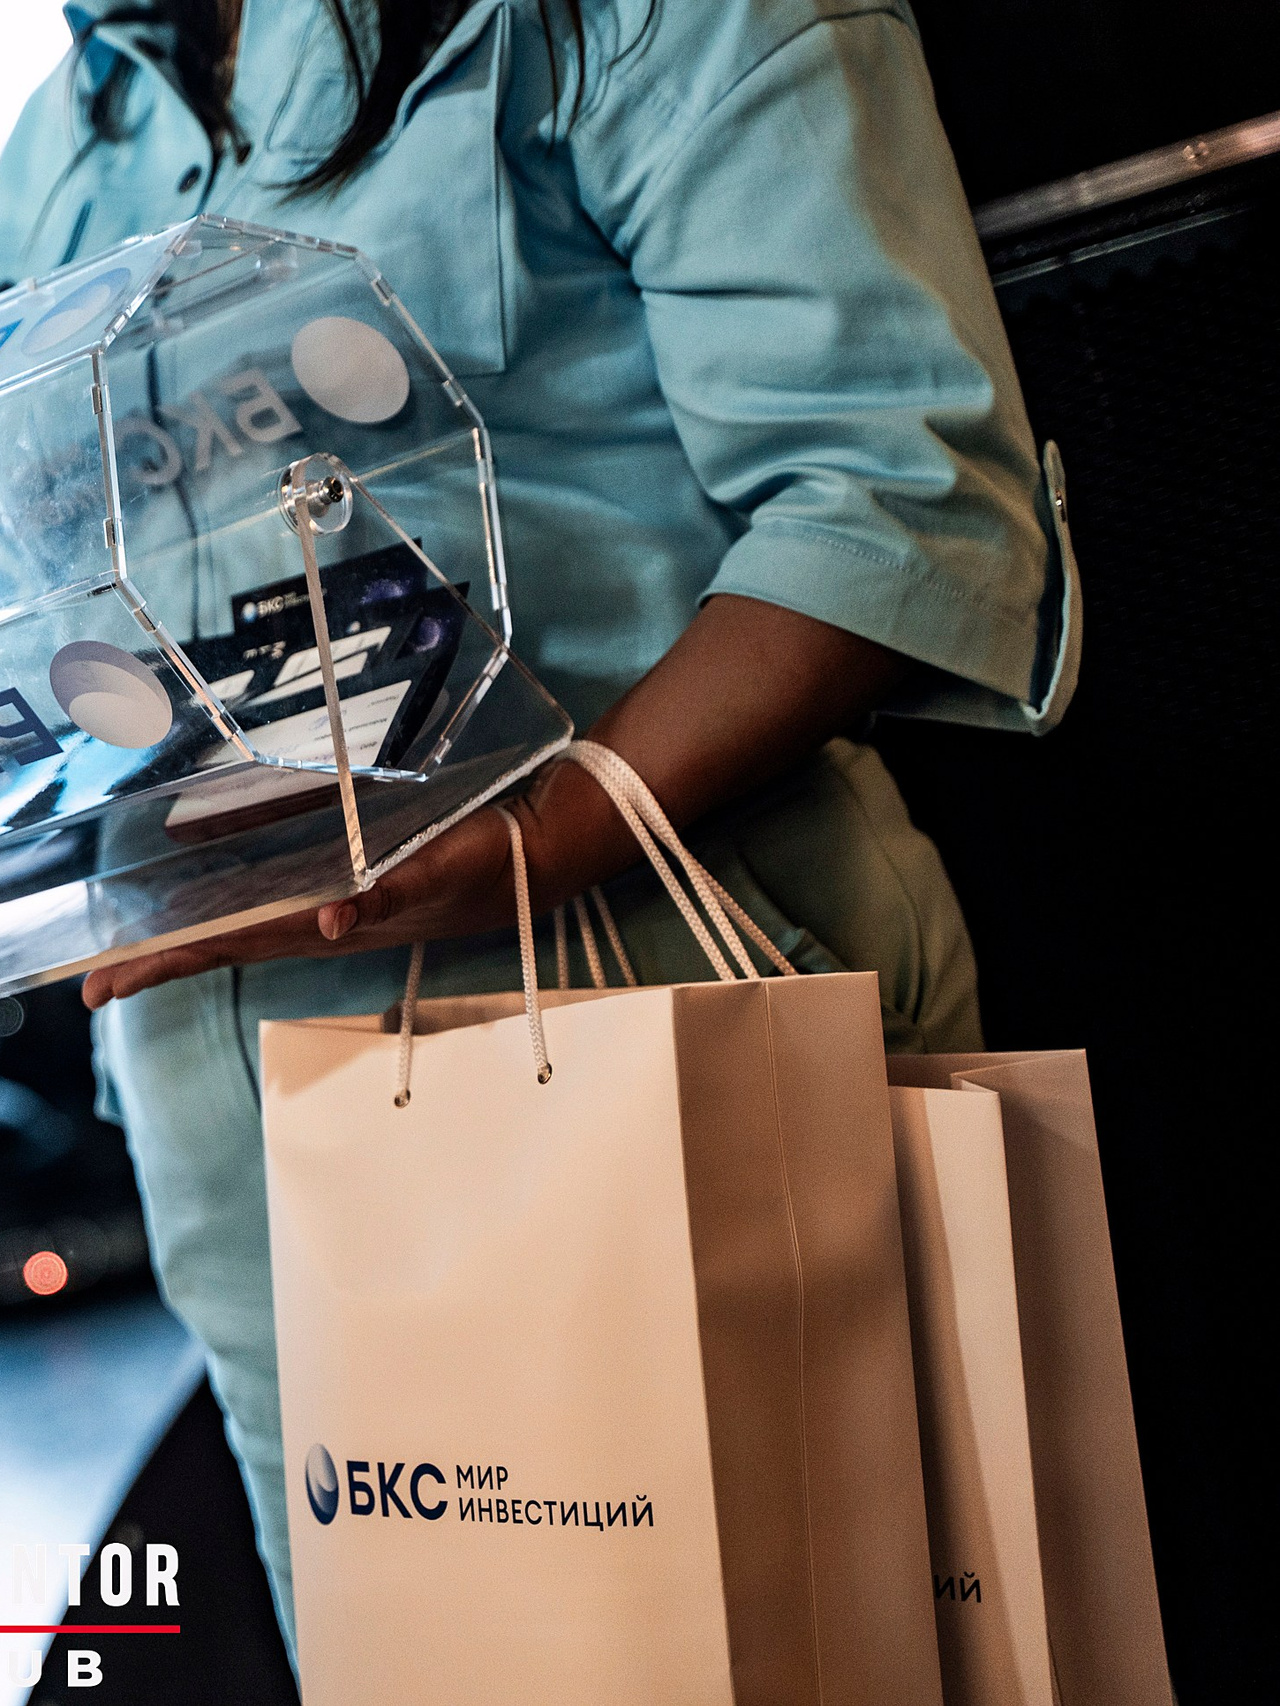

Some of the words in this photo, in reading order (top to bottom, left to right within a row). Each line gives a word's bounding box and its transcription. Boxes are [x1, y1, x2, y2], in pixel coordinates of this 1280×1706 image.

[346, 1459, 449, 1520] БКС
[455, 1464, 509, 1490] МИР
[458, 1494, 655, 1532] ИНВЕСТИЦИЙ
